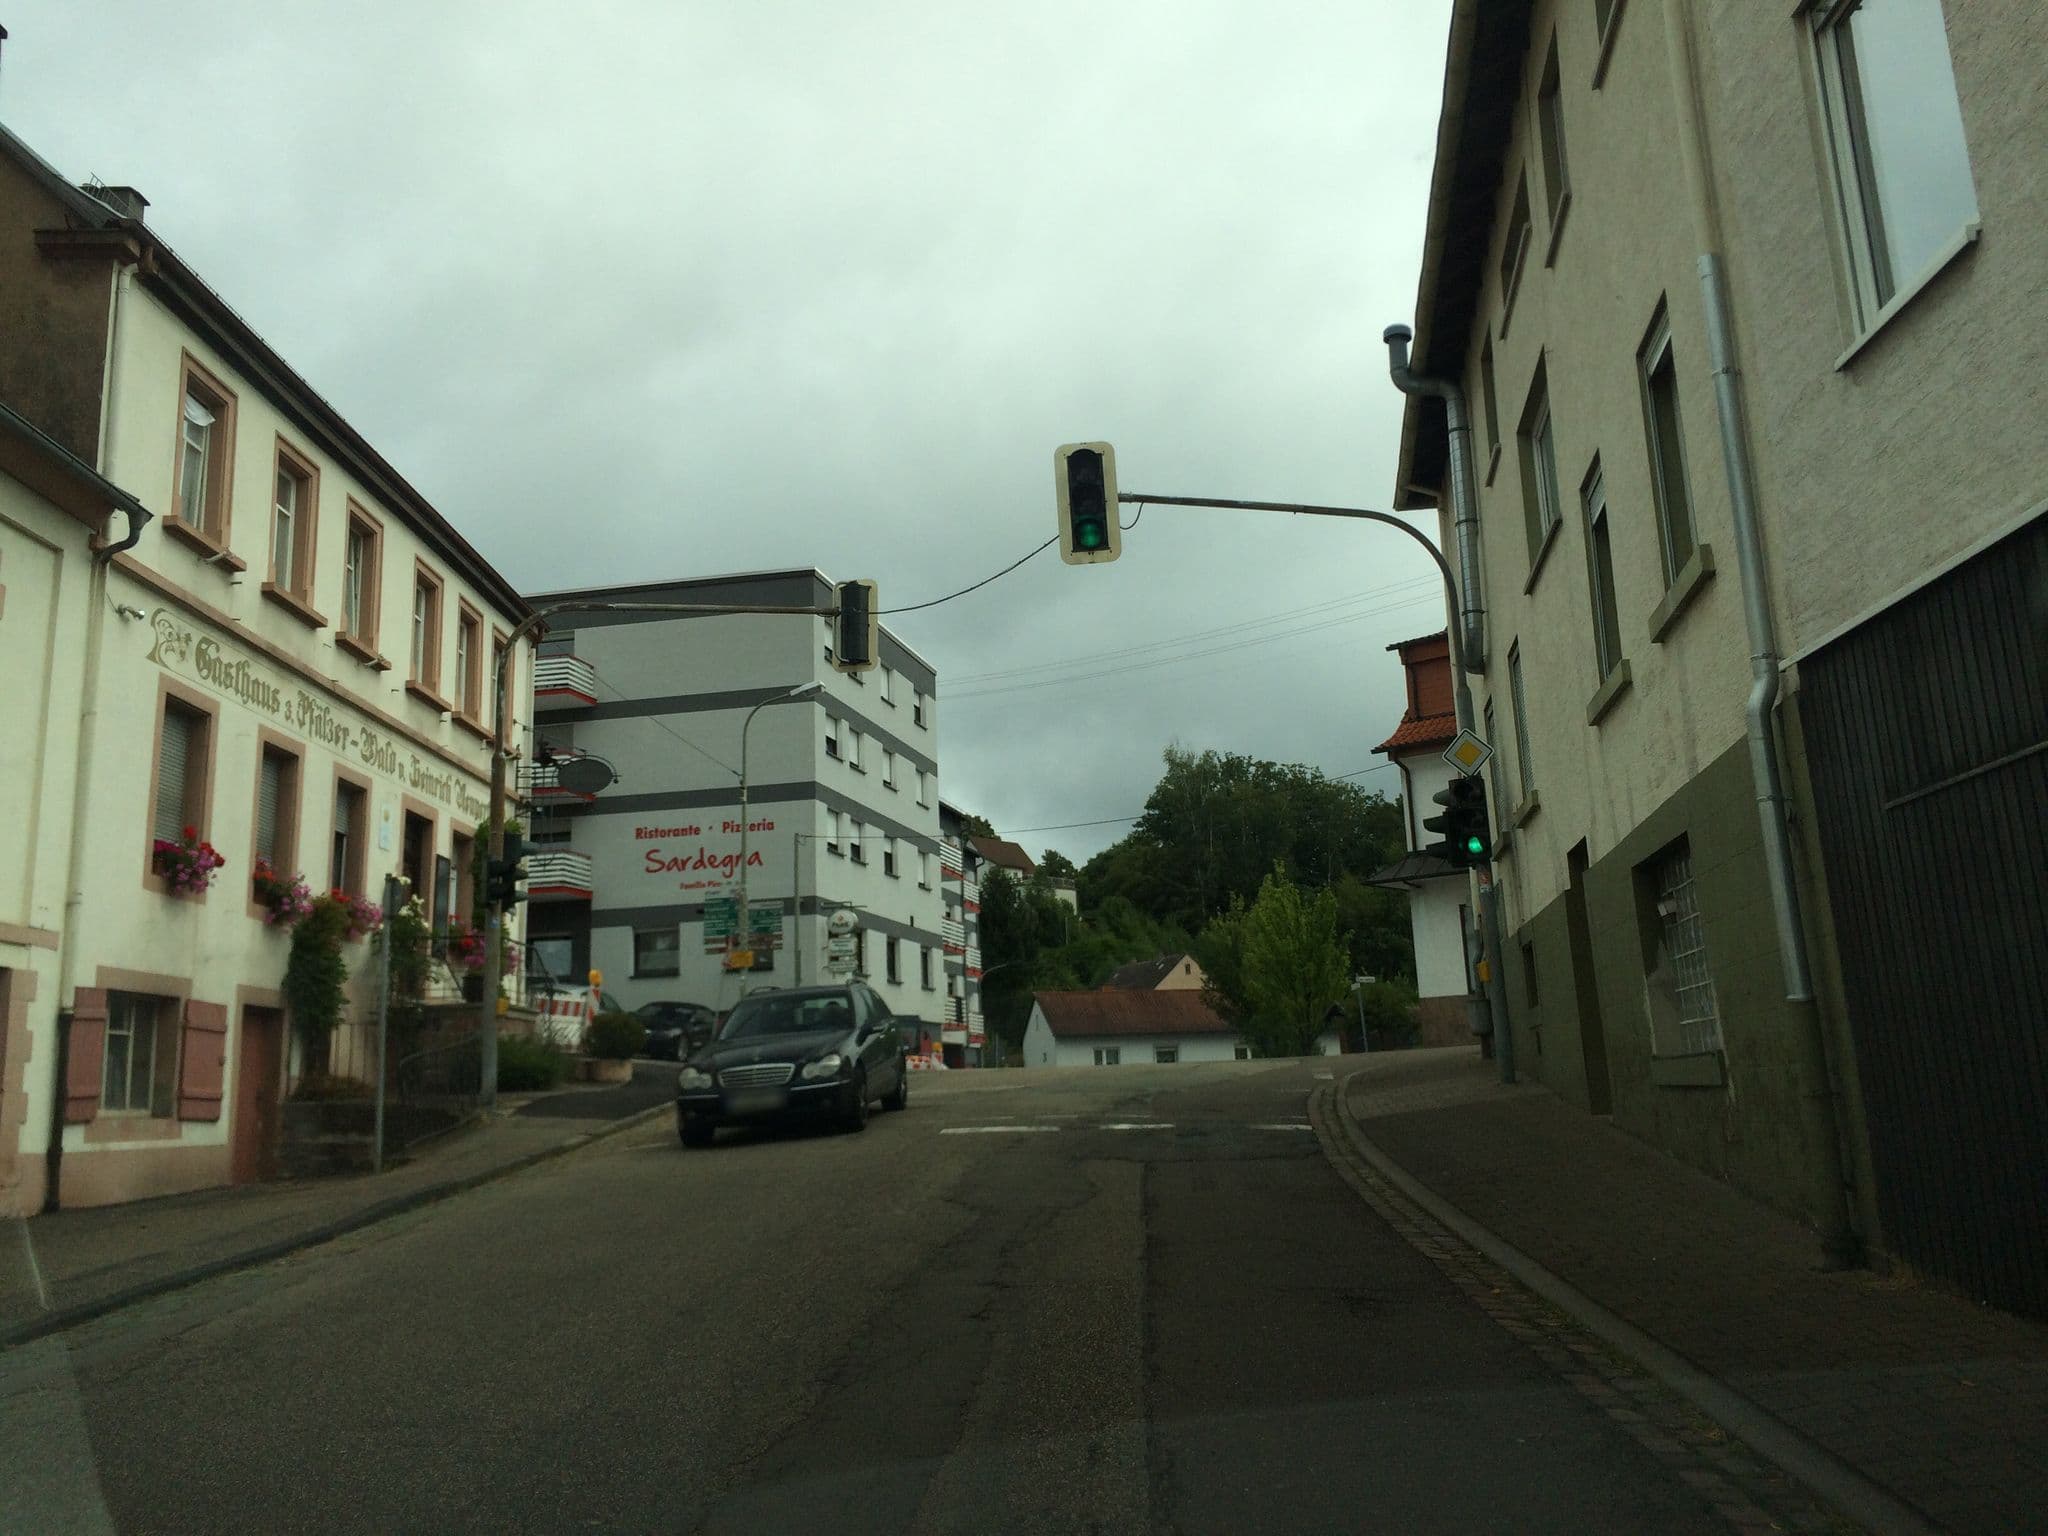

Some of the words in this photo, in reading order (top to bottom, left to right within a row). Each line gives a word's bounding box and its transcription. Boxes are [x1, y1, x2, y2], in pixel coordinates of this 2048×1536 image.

[195, 636, 280, 715] Gasthaus
[409, 754, 452, 804] Heinrich
[635, 825, 701, 840] Ristorante
[722, 818, 775, 833] Pizeria
[645, 847, 764, 878] Sardegna
